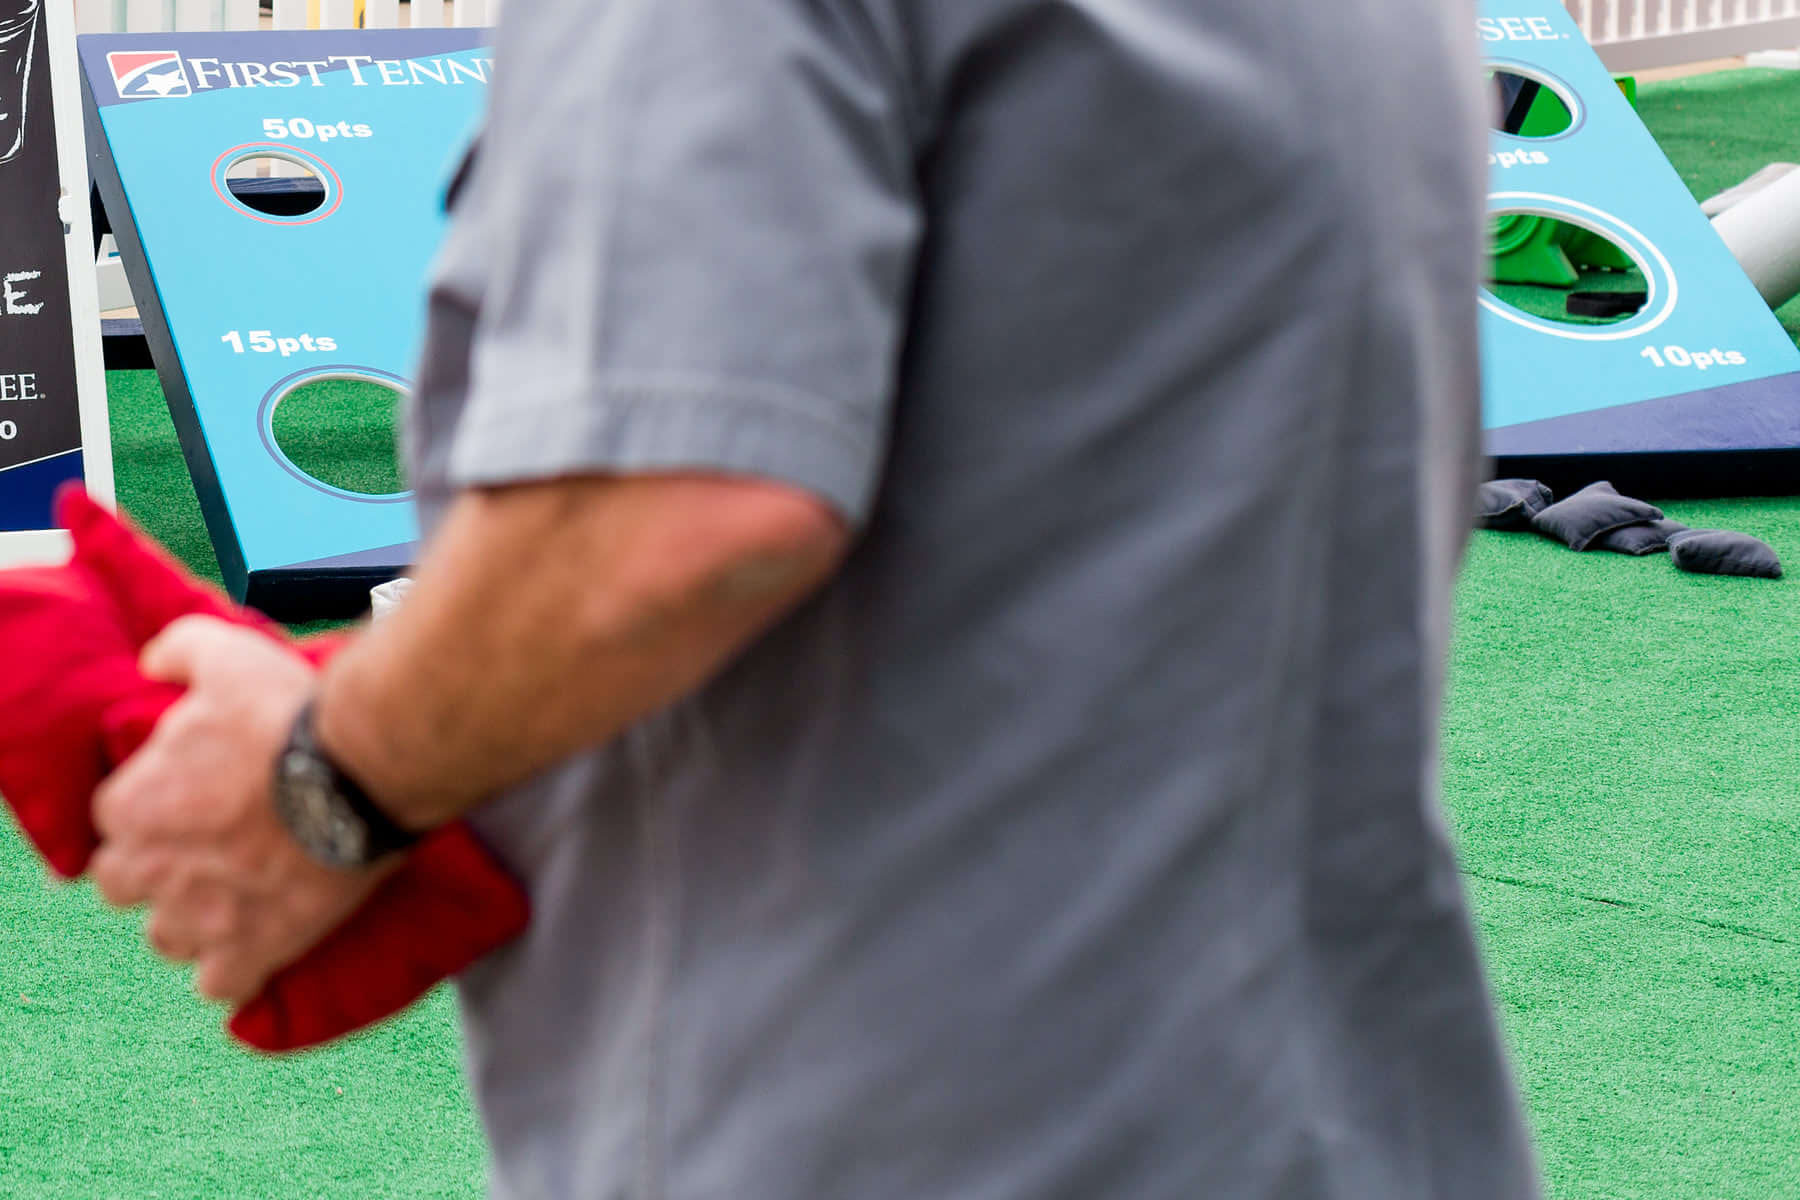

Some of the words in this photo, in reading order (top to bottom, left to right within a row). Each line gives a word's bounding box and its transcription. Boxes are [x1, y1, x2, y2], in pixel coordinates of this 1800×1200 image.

[187, 57, 329, 89] FIRST
[262, 117, 374, 142] 50pts
[220, 329, 339, 357] 15pts
[1640, 345, 1748, 370] 10pts
